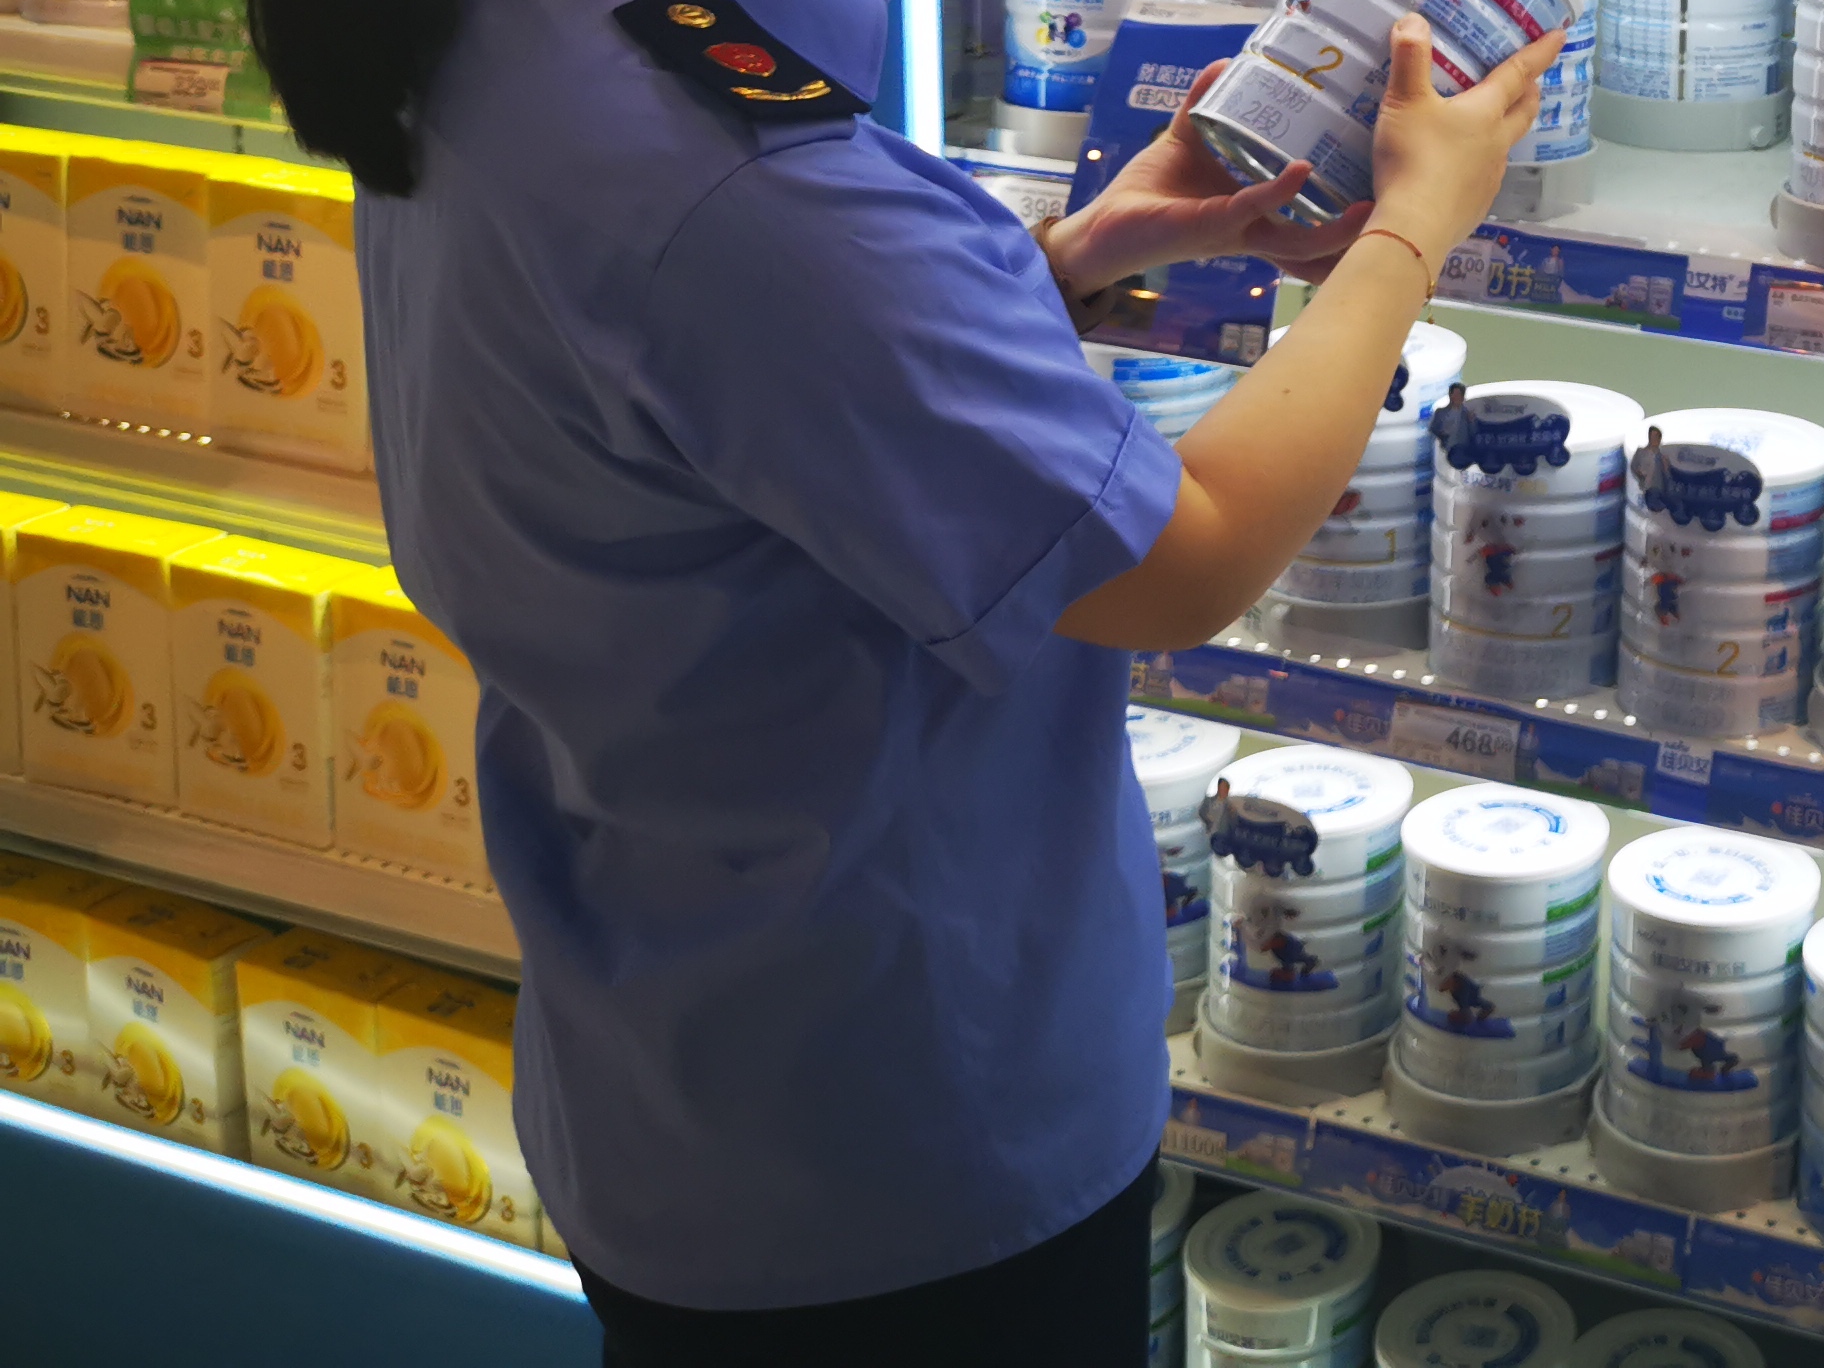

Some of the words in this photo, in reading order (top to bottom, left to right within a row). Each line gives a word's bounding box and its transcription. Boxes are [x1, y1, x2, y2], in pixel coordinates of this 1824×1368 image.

[1137, 63, 1204, 87] 就喝好
[1297, 46, 1345, 92] 2
[1552, 606, 1573, 639] 2
[1717, 642, 1739, 678] 2
